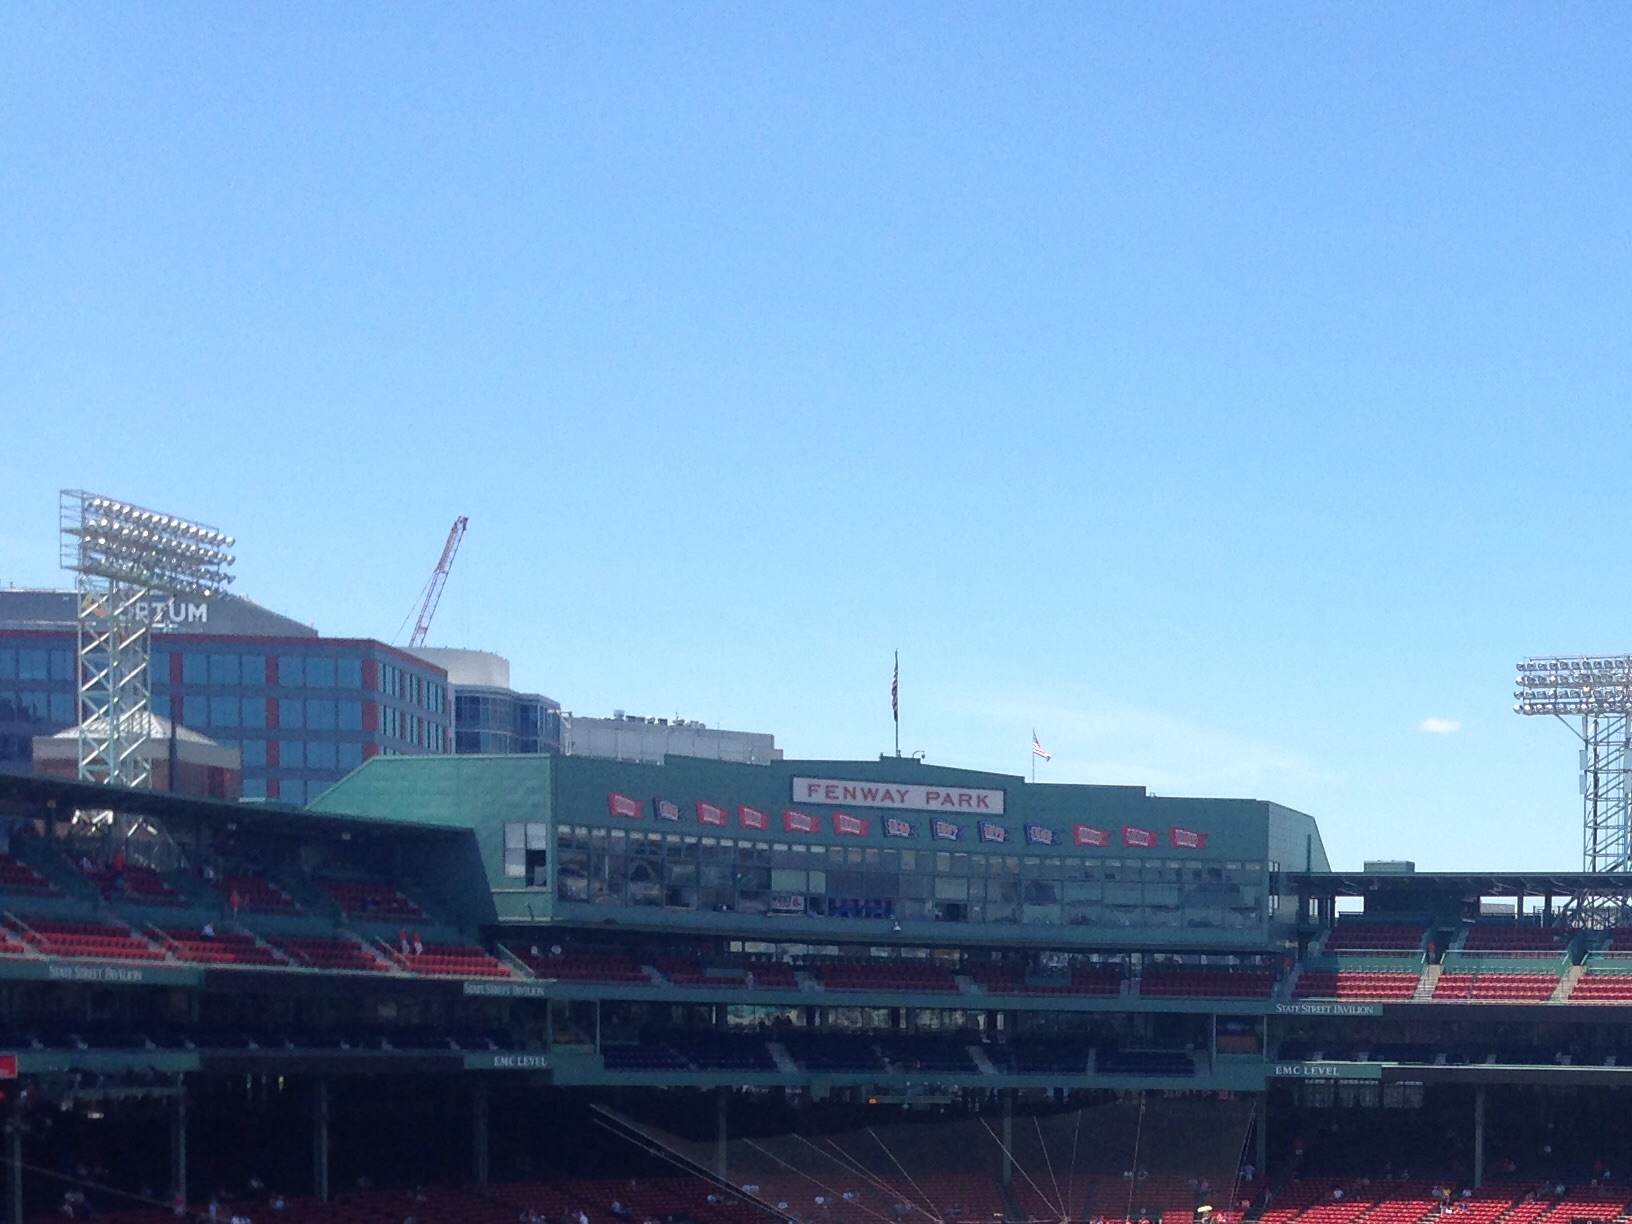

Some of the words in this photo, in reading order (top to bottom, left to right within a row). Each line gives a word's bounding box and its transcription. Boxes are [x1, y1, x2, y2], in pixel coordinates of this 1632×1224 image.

[807, 784, 909, 805] FENWAY
[926, 790, 989, 809] PARK
[1275, 1003, 1300, 1013] STATE
[1301, 1004, 1331, 1014] STREET
[1333, 1005, 1374, 1015] PAVILION
[517, 1056, 548, 1067] LEVEL
[1275, 1066, 1300, 1075] EMC
[1303, 1067, 1340, 1076] LEVEL
